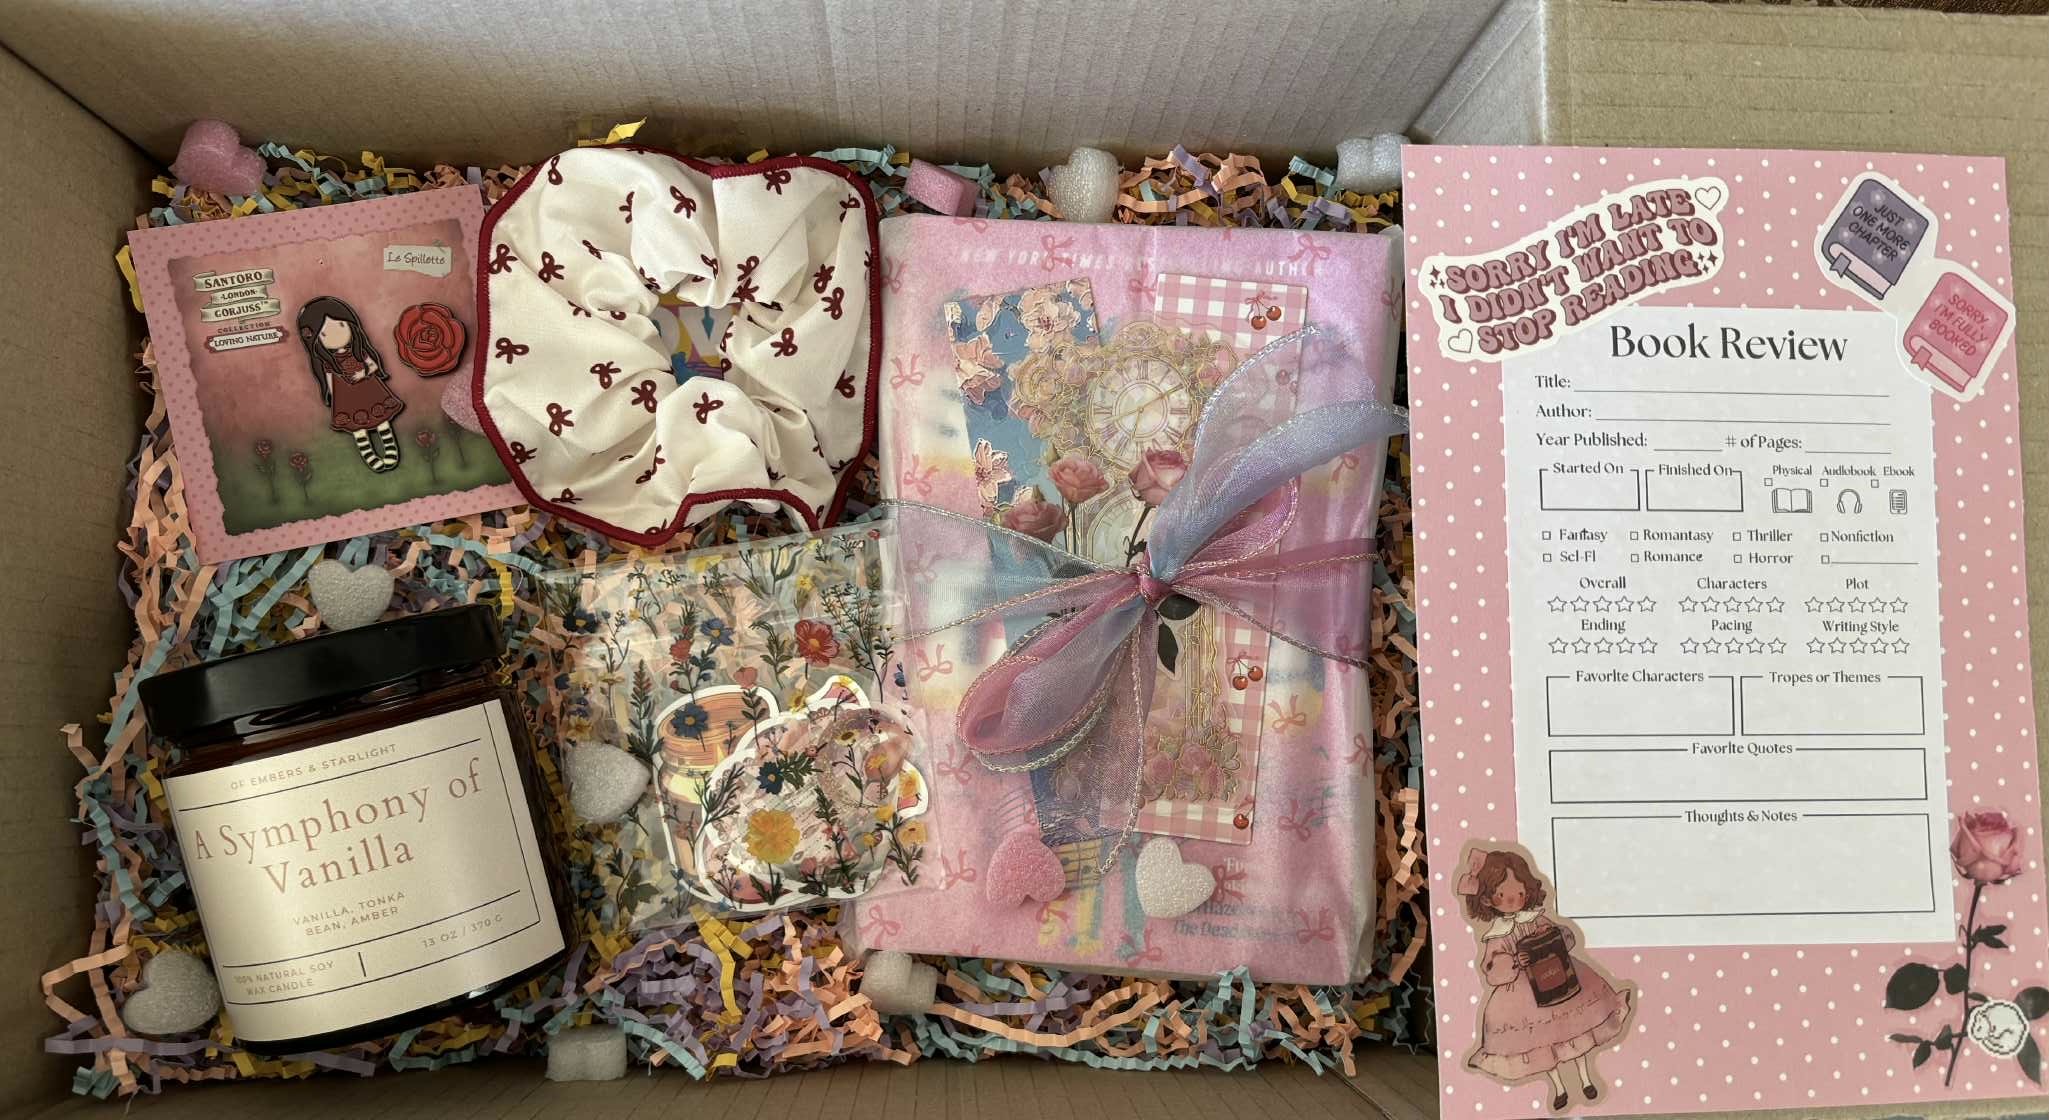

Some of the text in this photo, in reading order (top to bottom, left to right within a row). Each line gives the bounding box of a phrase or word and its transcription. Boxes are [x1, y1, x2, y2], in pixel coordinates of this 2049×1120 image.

[1874, 204, 1904, 226] JUST
[1852, 205, 1910, 250] ONE MORE
[1446, 188, 1695, 294] SORRY I'M LATE
[1848, 222, 1898, 262] CHAPTER
[1439, 217, 1718, 323] I DIDN'T WANT TO
[205, 271, 262, 288] SANTORO
[1478, 249, 1702, 355] STOP READING
[217, 321, 271, 333] COLLECTION
[1933, 304, 1988, 344] I'M FULLY
[214, 332, 278, 347] LOVING NATURE
[1609, 323, 1849, 361] Book Review
[1928, 319, 1977, 357] BOOKED
[1535, 374, 1571, 390] Title:
[1535, 403, 1593, 419] Author:
[1535, 432, 1803, 450] Year Published: # of Pages:
[1552, 462, 1624, 475] Started On
[1658, 463, 1734, 476] Finished On
[1772, 465, 1813, 477] Physical
[1821, 465, 1877, 477] Audiobook
[1882, 465, 1915, 477] Ebook
[1559, 529, 1608, 543] Fantasy
[1643, 529, 1714, 543] Romantasy
[1746, 529, 1793, 542] Thriller
[1831, 530, 1895, 543] Nonfiction
[1559, 550, 1597, 564] Sci-Fi
[1643, 551, 1703, 563] Romance
[1748, 552, 1794, 564] Horror
[1579, 577, 1627, 589] Overall
[1697, 577, 1768, 590] Characters
[1845, 578, 1869, 590] Plot
[1580, 619, 1626, 633] Ending
[1711, 619, 1753, 633] Pacing
[1822, 620, 1900, 634] Writing Style
[1575, 669, 1705, 683] Favorite Characters
[1769, 671, 1881, 685] Tropes or Themes
[1692, 742, 1793, 756] Favorite Quotes
[230, 743, 398, 790] OF EMBERS & STARLIGHT
[194, 757, 483, 865] A Symphony of
[1685, 809, 1798, 824] Thoughts & Notes
[262, 833, 415, 894] Vanilla
[293, 892, 405, 925] VANILLA, TONKA
[305, 906, 399, 936] BEAN, AMBER
[422, 938, 435, 948] 13
[440, 930, 458, 942] OZ
[256, 968, 306, 982] NATURAL
[310, 961, 334, 973] SOY
[246, 978, 313, 996] WAX CANDLE
